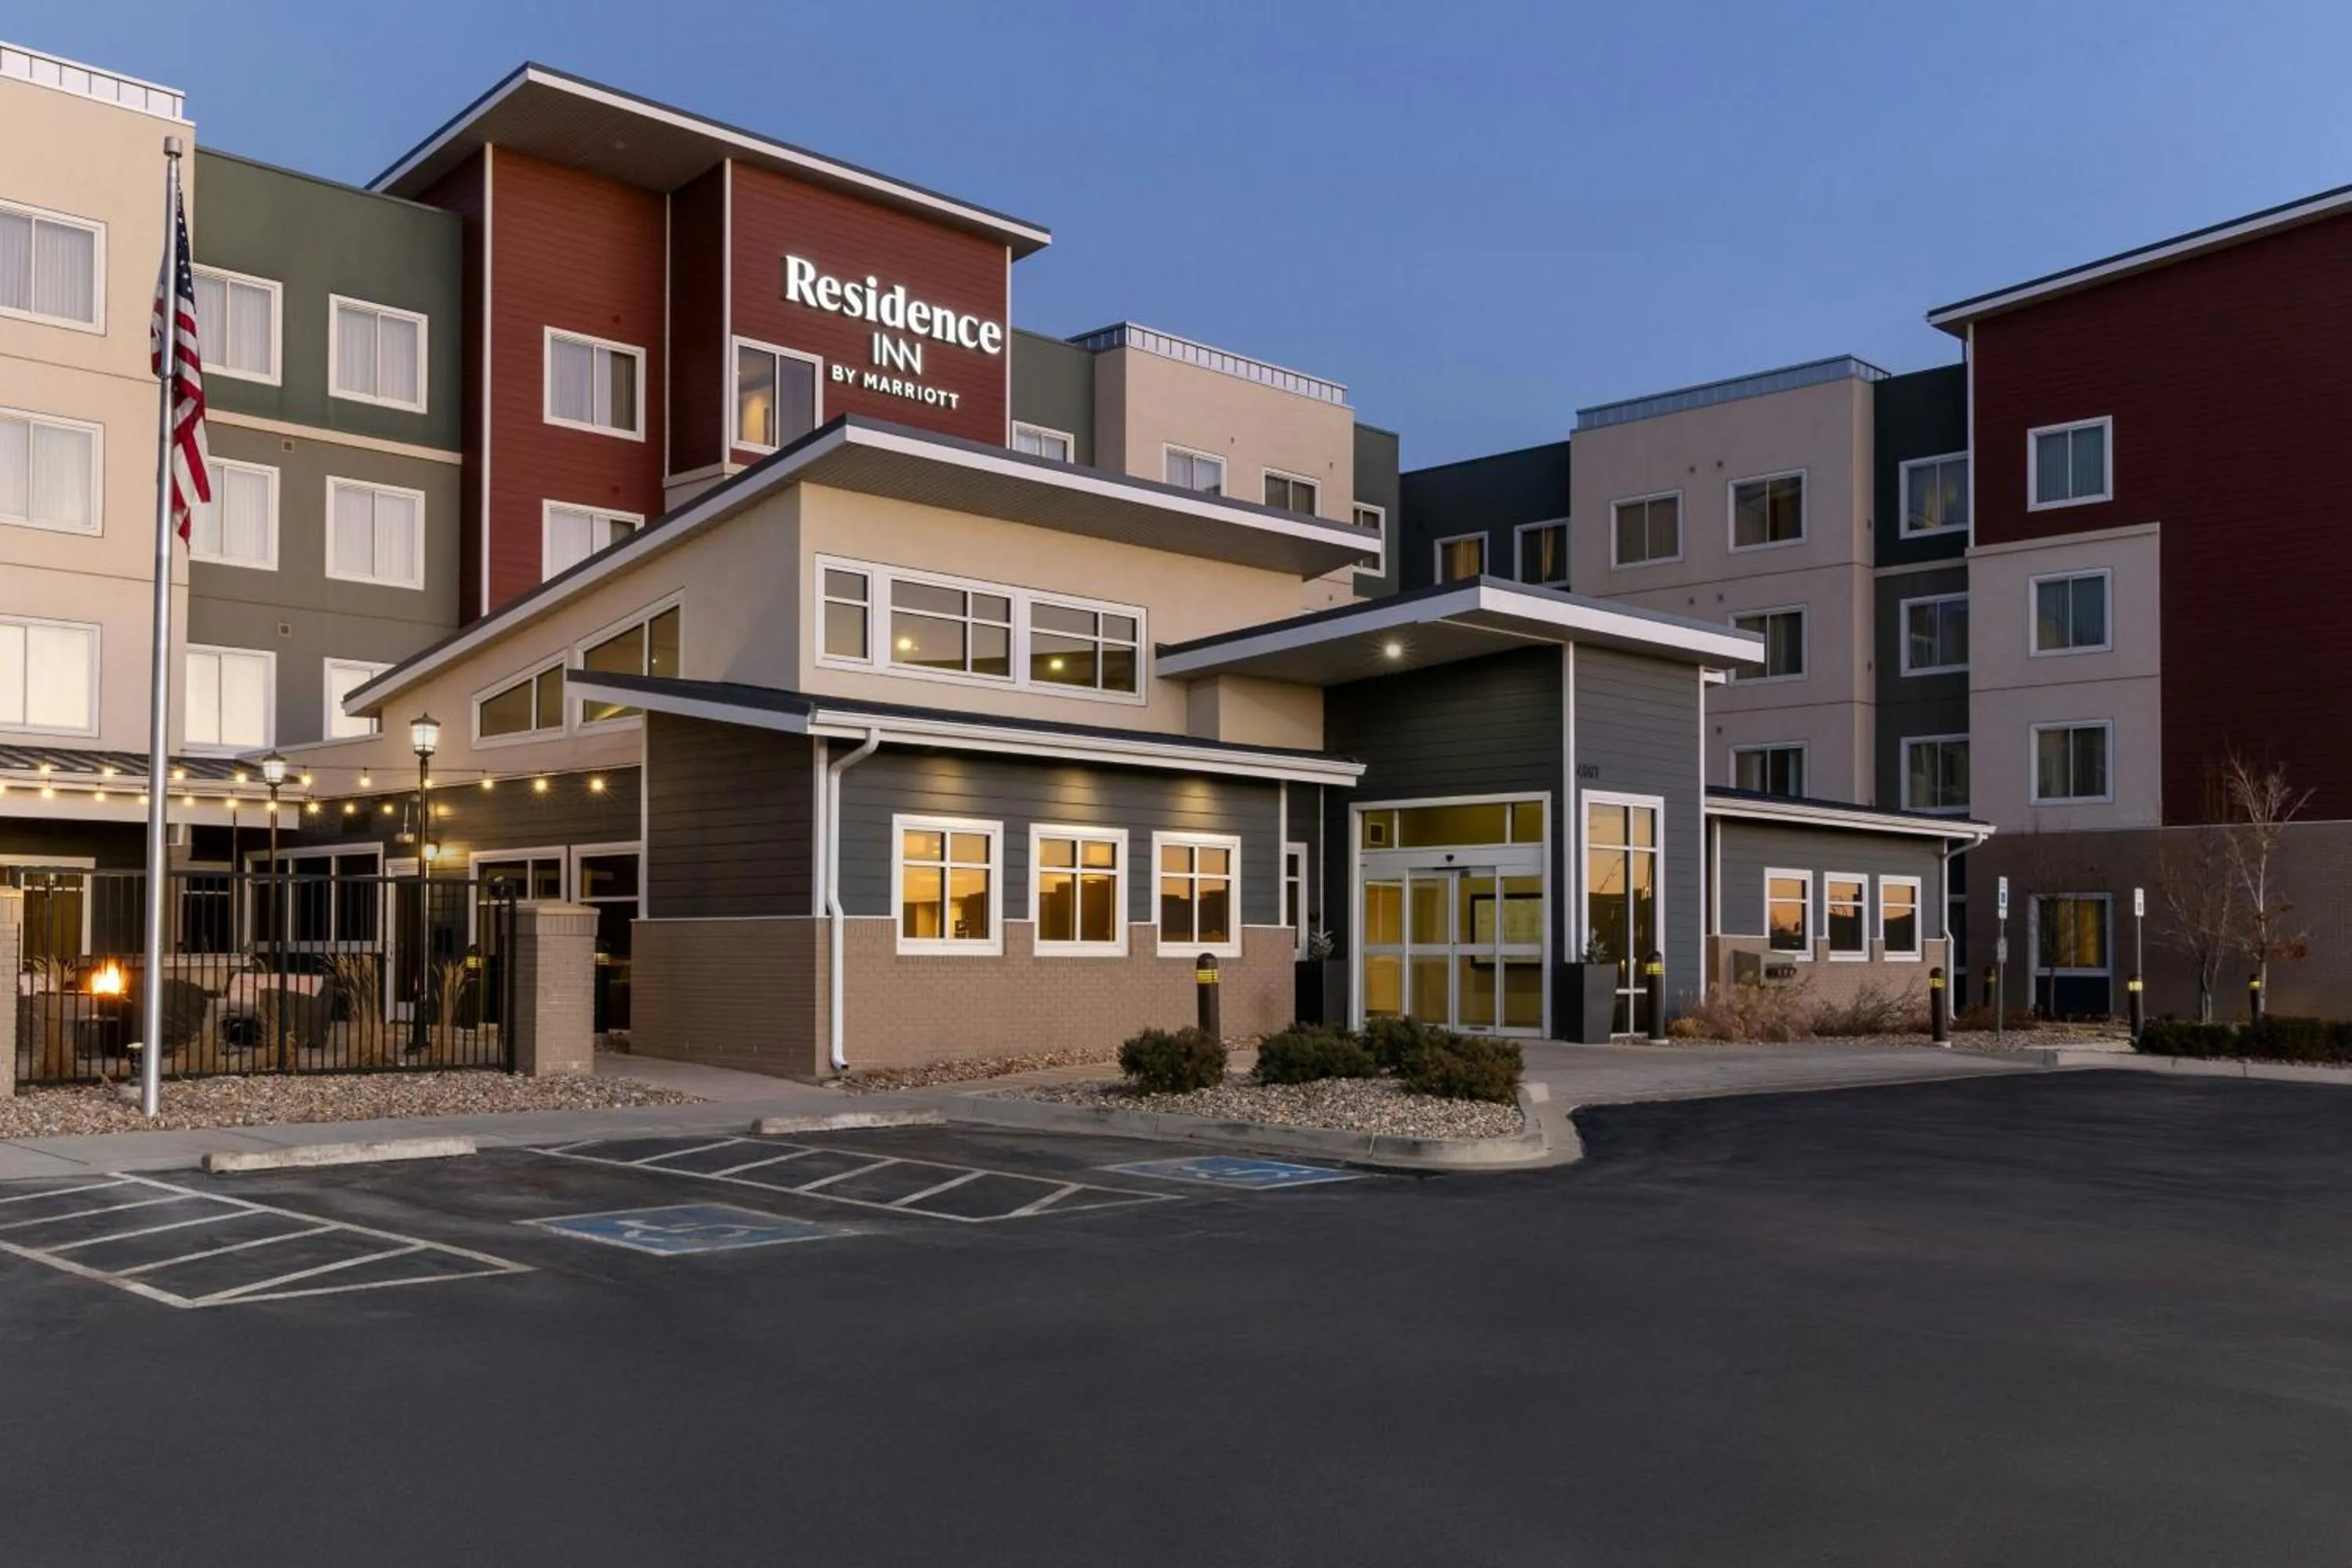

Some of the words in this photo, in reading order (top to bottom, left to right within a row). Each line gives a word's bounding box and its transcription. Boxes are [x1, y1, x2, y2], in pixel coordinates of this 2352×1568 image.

[786, 255, 1003, 355] Residence
[873, 332, 922, 376] INN
[832, 365, 856, 384] BY
[864, 372, 960, 409] MARRIOTT
